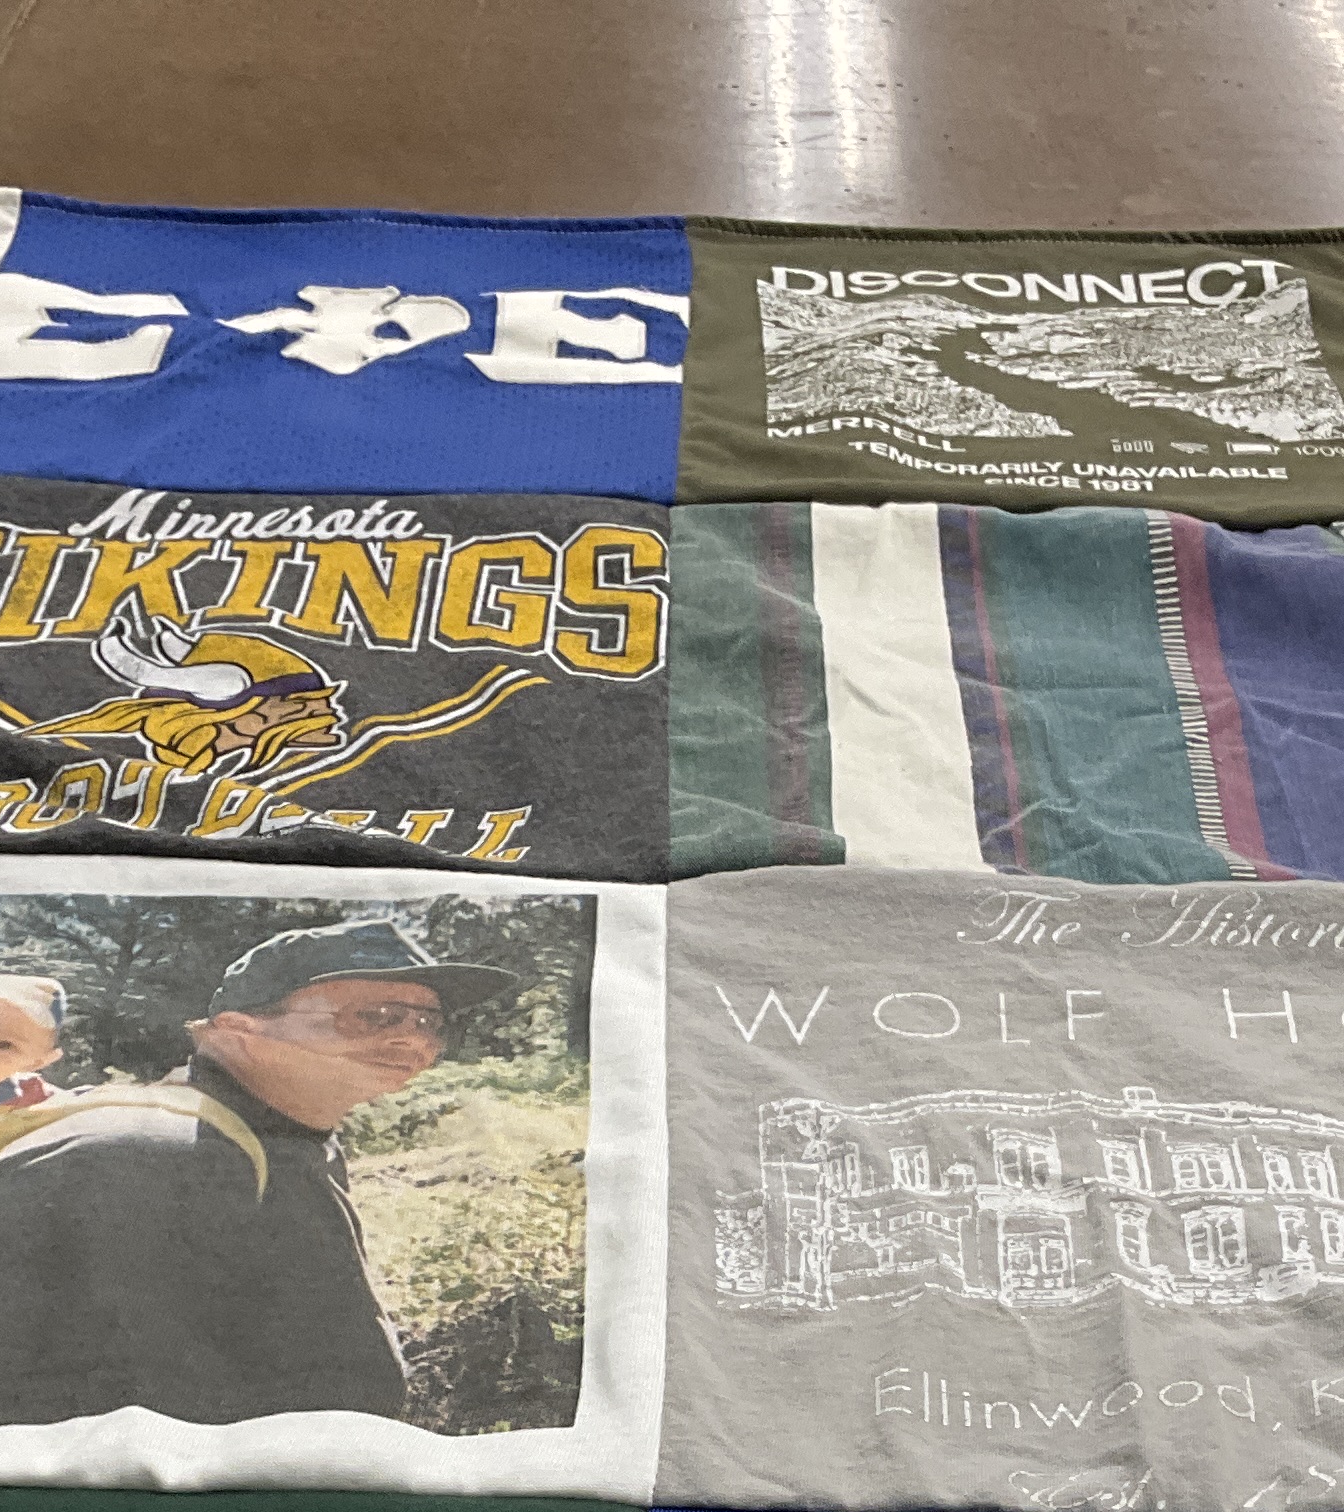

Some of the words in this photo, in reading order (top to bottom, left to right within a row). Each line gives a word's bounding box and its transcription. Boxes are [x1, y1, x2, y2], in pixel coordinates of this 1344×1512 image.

[770, 259, 1294, 307] DISCONNECT
[767, 417, 966, 453] MERRELL
[848, 441, 1064, 476] TEMPORARILY
[1072, 461, 1288, 480] UNAVAILABLE
[1089, 480, 1154, 493] 1981
[70, 490, 426, 540] Minnesota
[957, 888, 1081, 946] The
[714, 985, 1106, 1046] WOLF
[874, 1366, 1284, 1434] Ellinwood,
